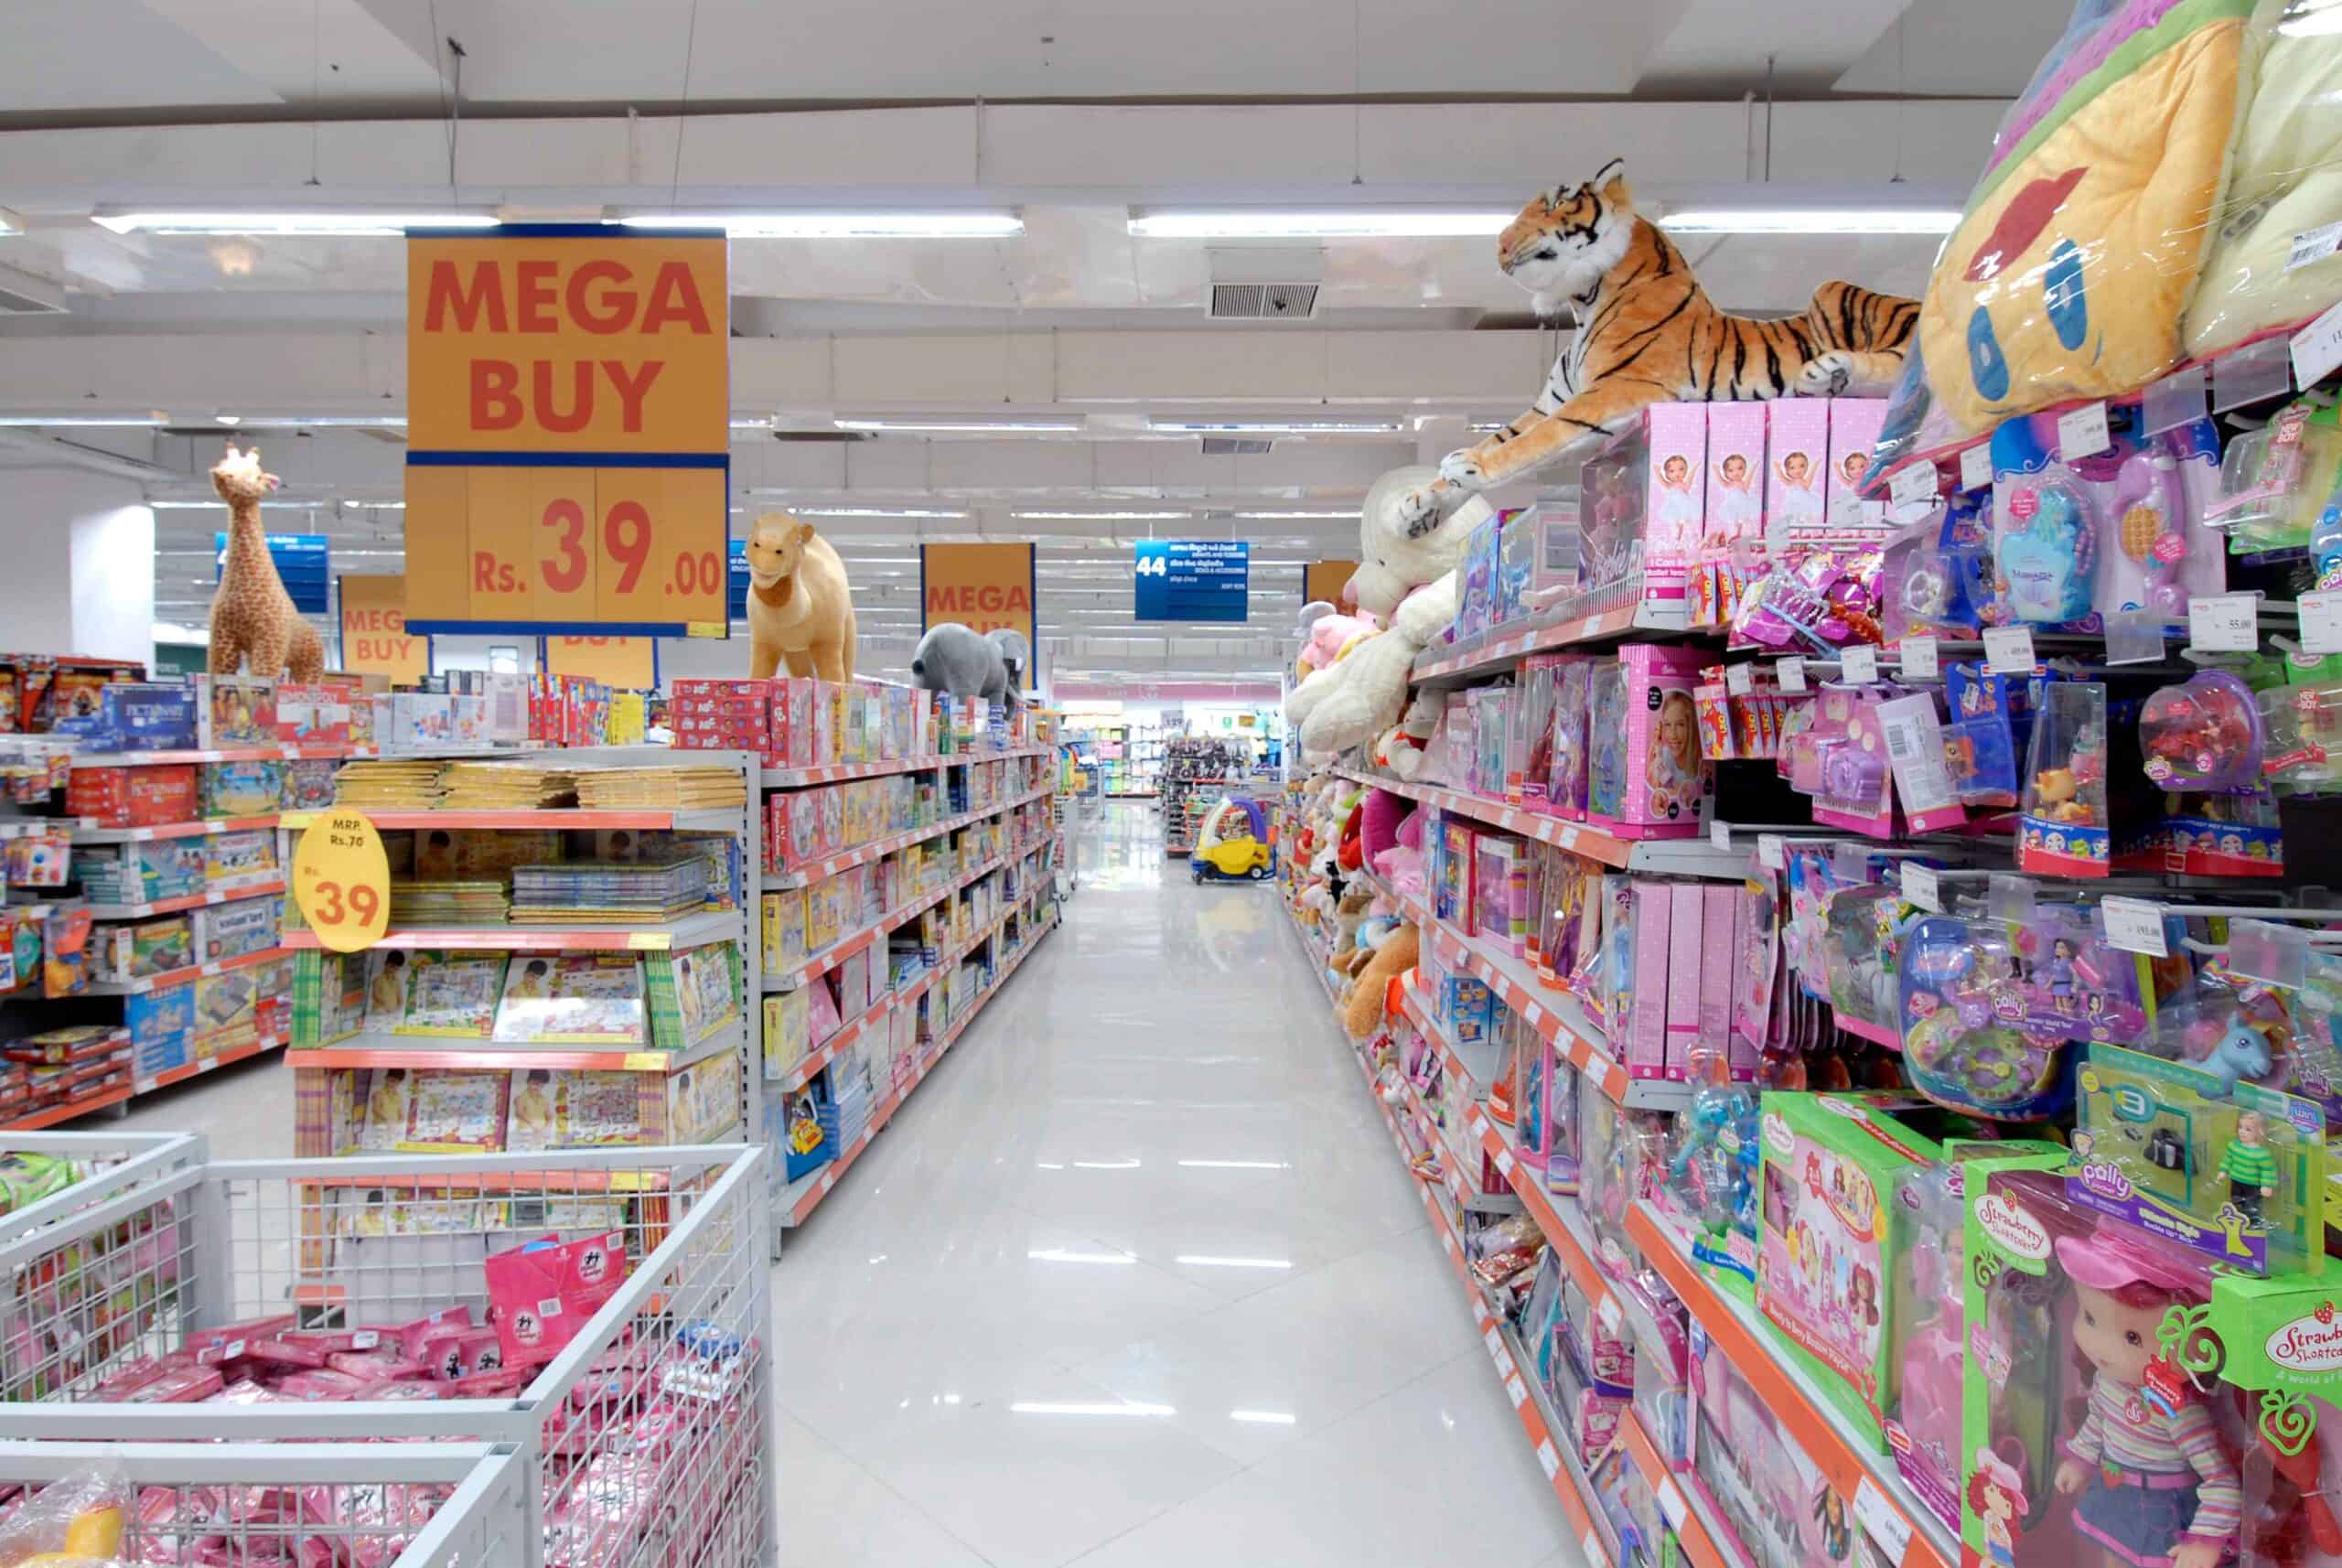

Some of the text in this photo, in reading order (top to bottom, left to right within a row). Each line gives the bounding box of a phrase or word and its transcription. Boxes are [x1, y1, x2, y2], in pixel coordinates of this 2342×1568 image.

[424, 259, 713, 336] MEGA
[469, 359, 666, 433] BUY
[474, 551, 527, 593] Rs.
[1136, 555, 1166, 576] 44
[927, 585, 1030, 613] MEGA
[344, 609, 403, 631] MEG
[357, 639, 412, 660] BUY
[330, 834, 365, 847] Rs.70
[315, 880, 380, 928] 39
[1980, 1199, 2044, 1251] Strawberry
